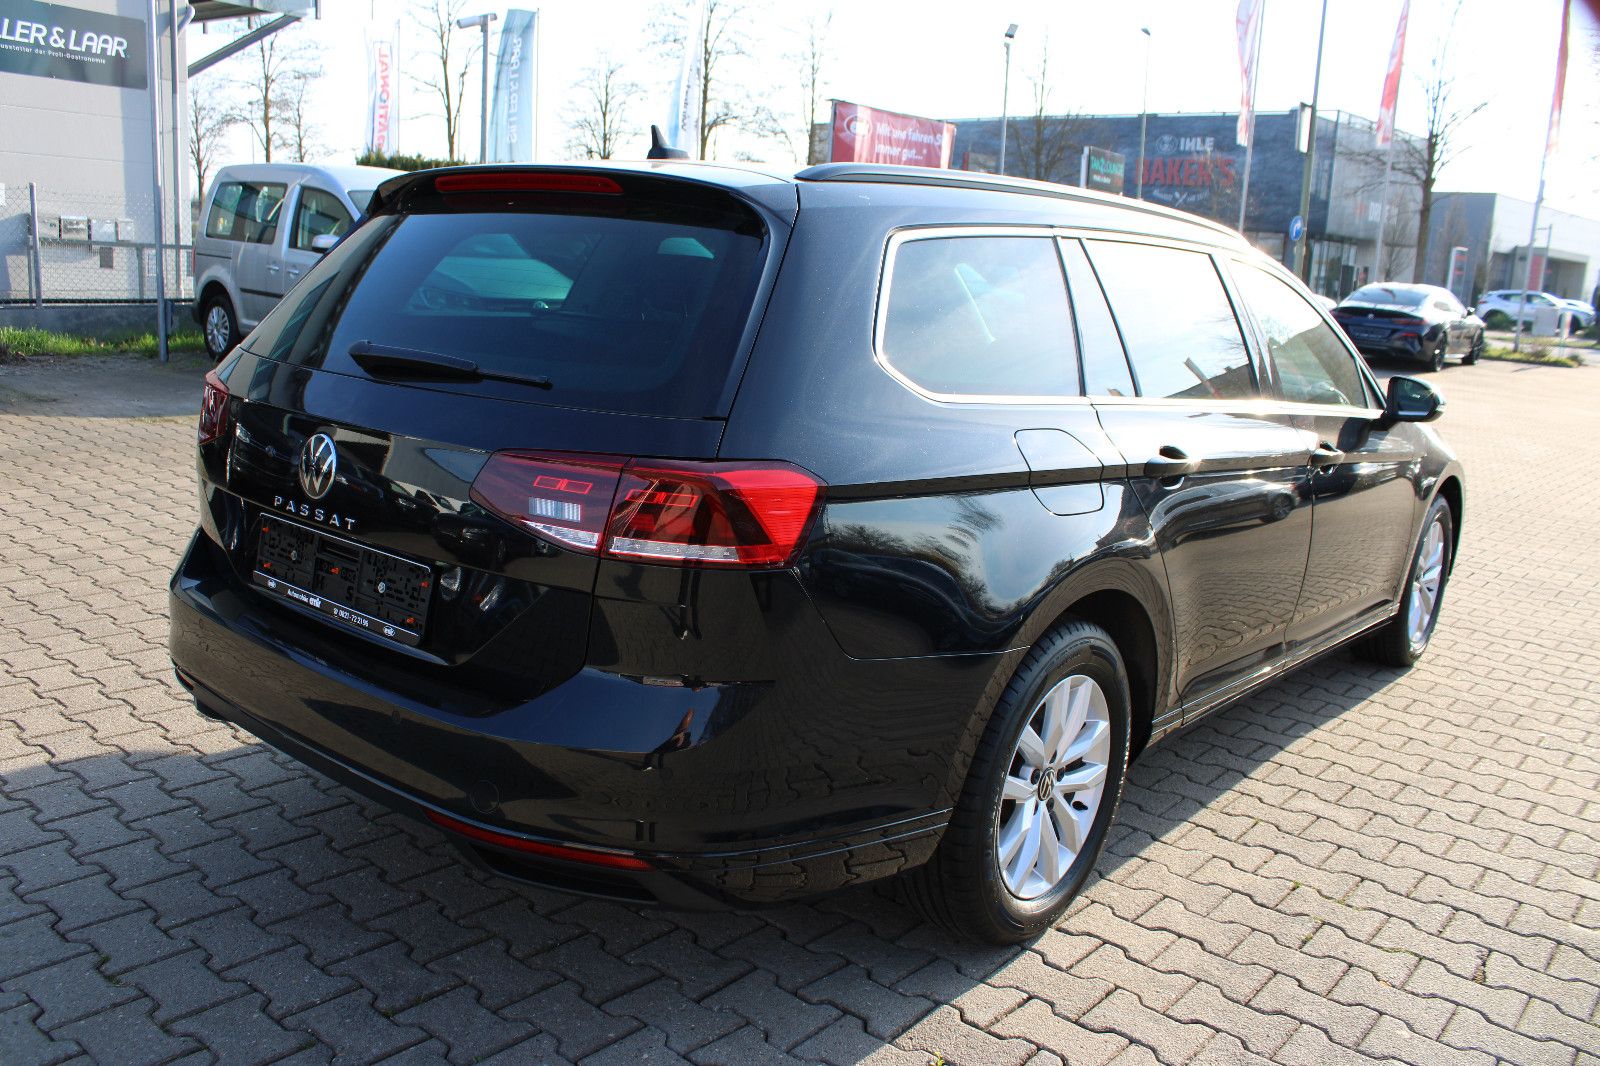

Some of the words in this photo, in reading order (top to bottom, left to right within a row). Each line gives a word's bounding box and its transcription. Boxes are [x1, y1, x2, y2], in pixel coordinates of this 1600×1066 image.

[0, 18, 47, 46] LER
[69, 29, 128, 59] LAAR
[1180, 136, 1215, 152] IHLE
[274, 495, 356, 530] PASSAT
